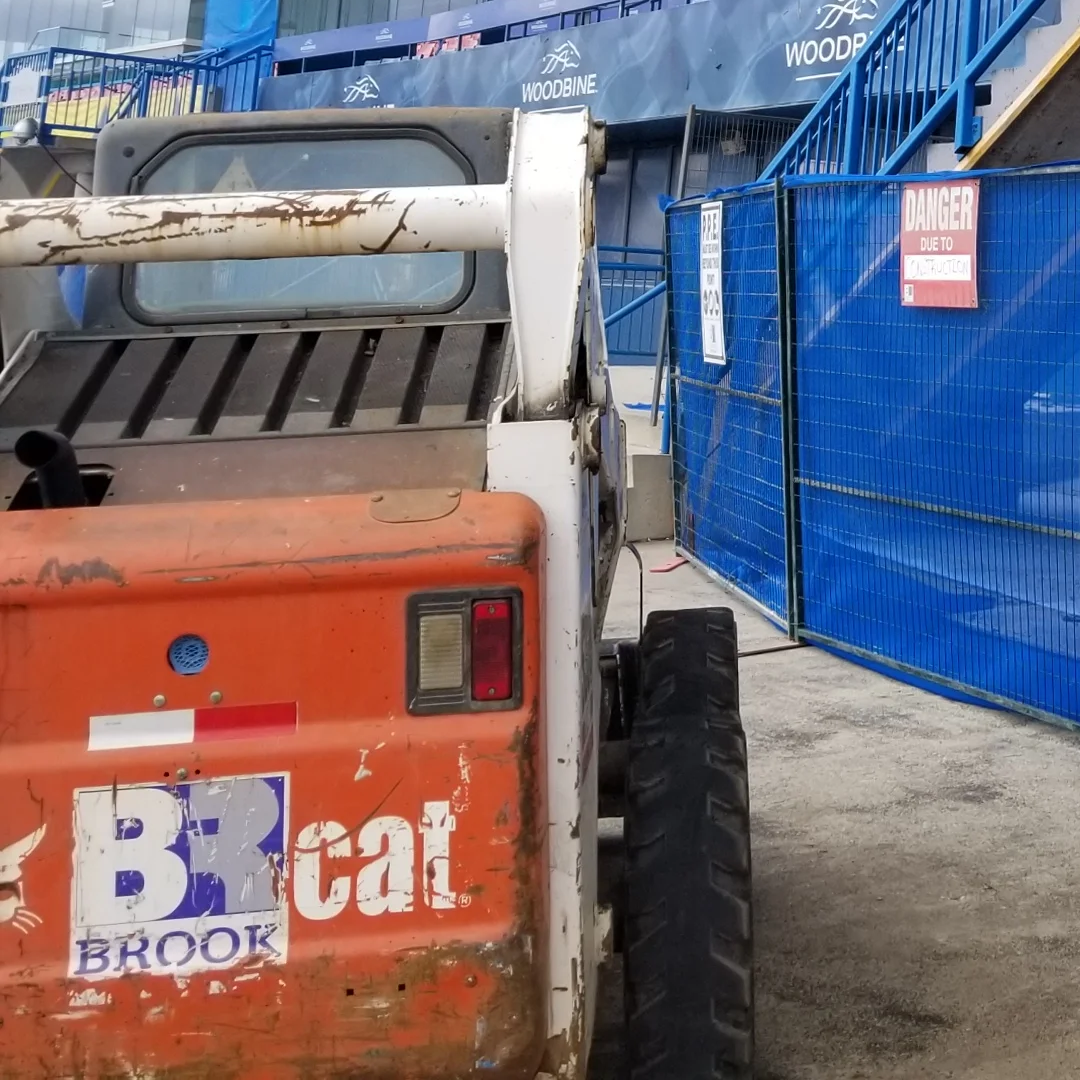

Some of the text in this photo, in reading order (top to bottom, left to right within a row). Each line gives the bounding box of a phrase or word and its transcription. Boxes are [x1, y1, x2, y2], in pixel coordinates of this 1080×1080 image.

[521, 73, 598, 104] WOODBINE
[905, 186, 974, 232] DANGER
[920, 236, 954, 252] DUE TO
[74, 922, 283, 976] BROOK
